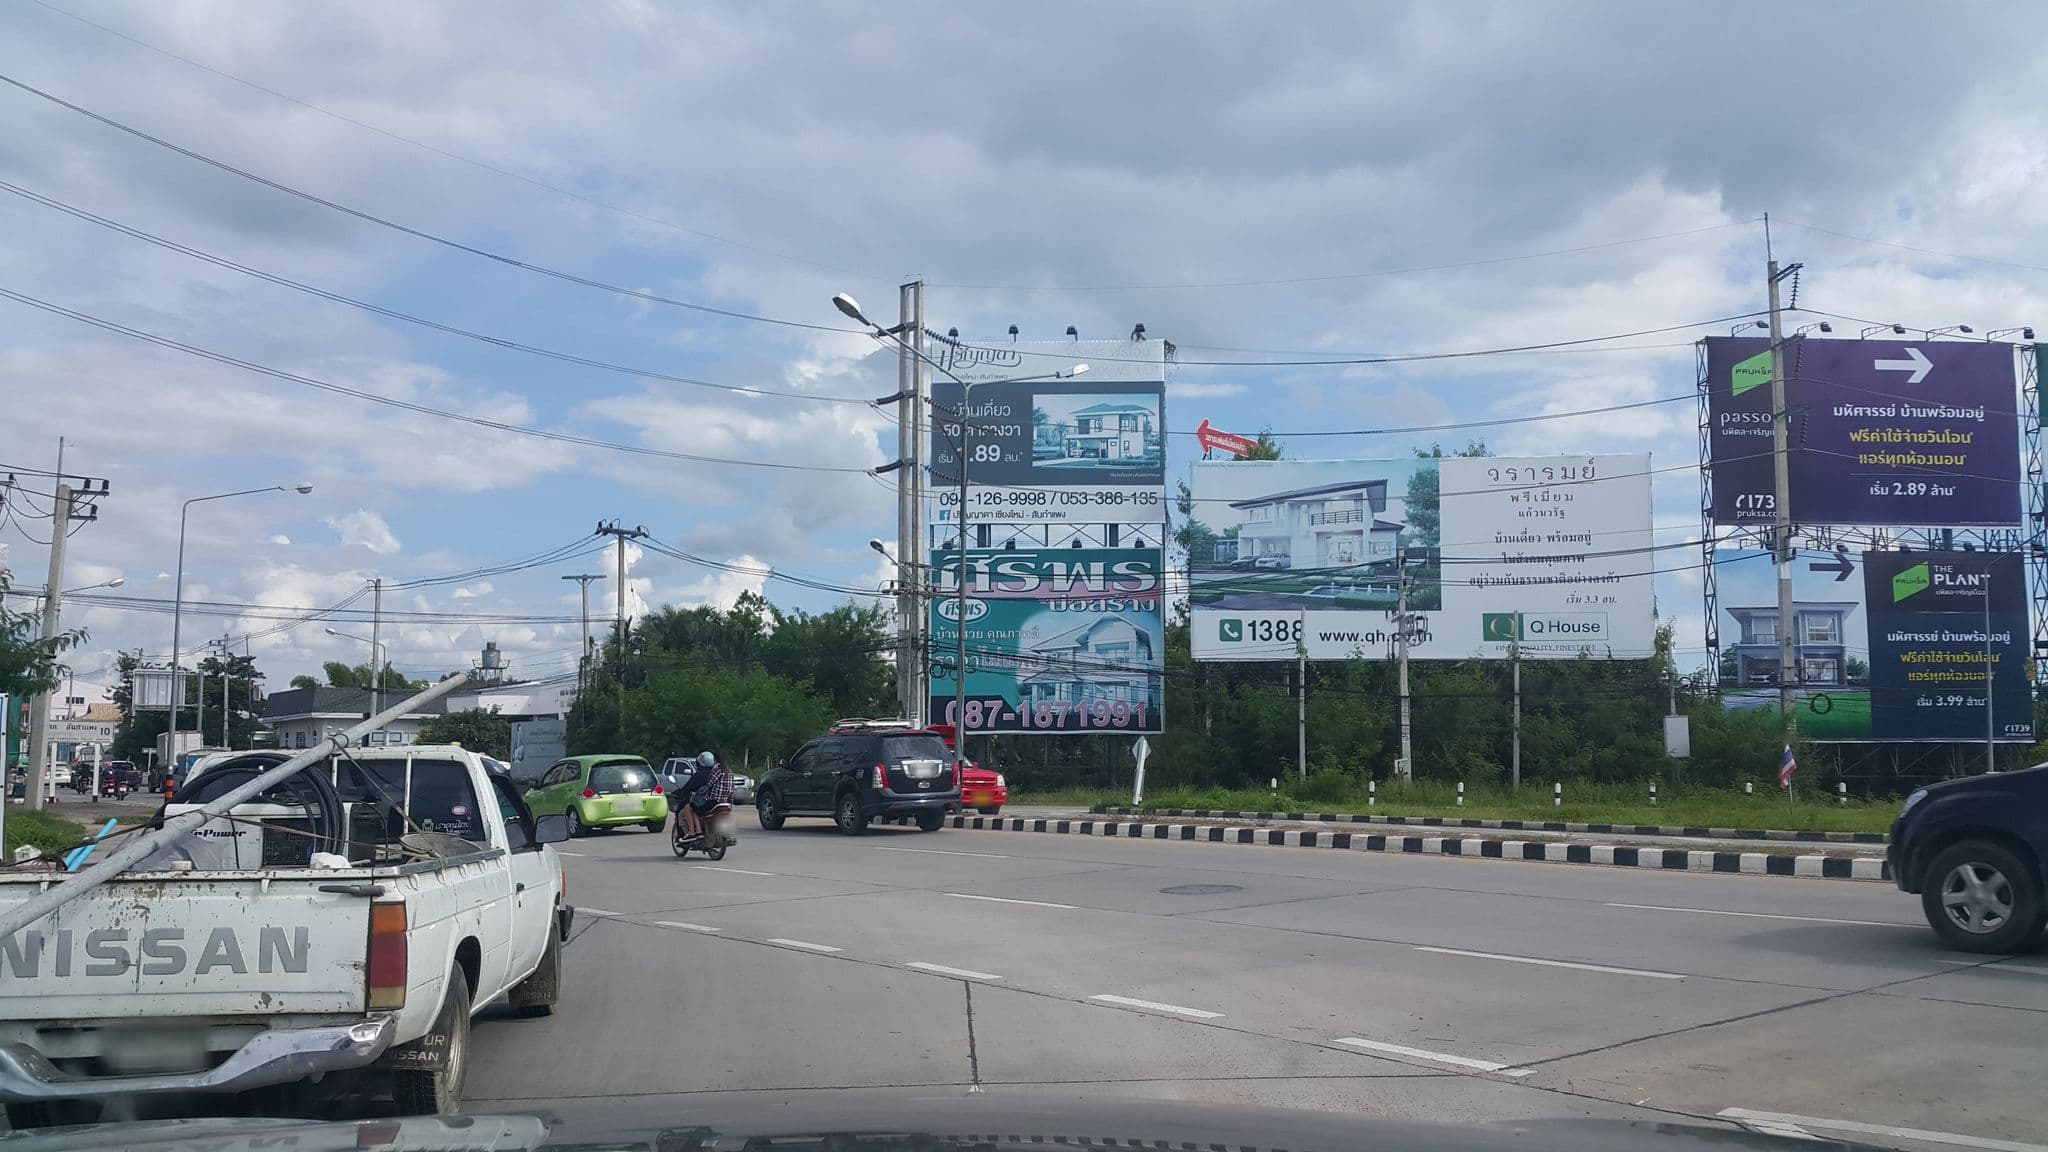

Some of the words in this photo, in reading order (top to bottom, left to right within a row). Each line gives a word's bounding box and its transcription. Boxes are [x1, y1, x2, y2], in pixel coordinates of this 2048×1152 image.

[1833, 403, 1896, 417] มหัศจรรย์
[1900, 403, 1985, 422] บ้านพร้อมอยู่
[956, 443, 1001, 463] .89
[1487, 457, 1596, 482] วรารมย์
[1870, 481, 1889, 496] เริ่ม
[1892, 482, 1927, 496] 2.89
[940, 491, 1047, 506] 09-126-9998
[1060, 491, 1158, 505] 053-386-135
[1748, 494, 1776, 509] 173
[1934, 574, 1991, 585] PLANT
[1248, 620, 1303, 642] 1388
[1530, 620, 1544, 634] Q
[1548, 620, 1600, 633] House
[1936, 696, 1963, 706] 3.99
[945, 699, 1148, 729] 087-1871991
[0, 926, 309, 978] NISSAN
